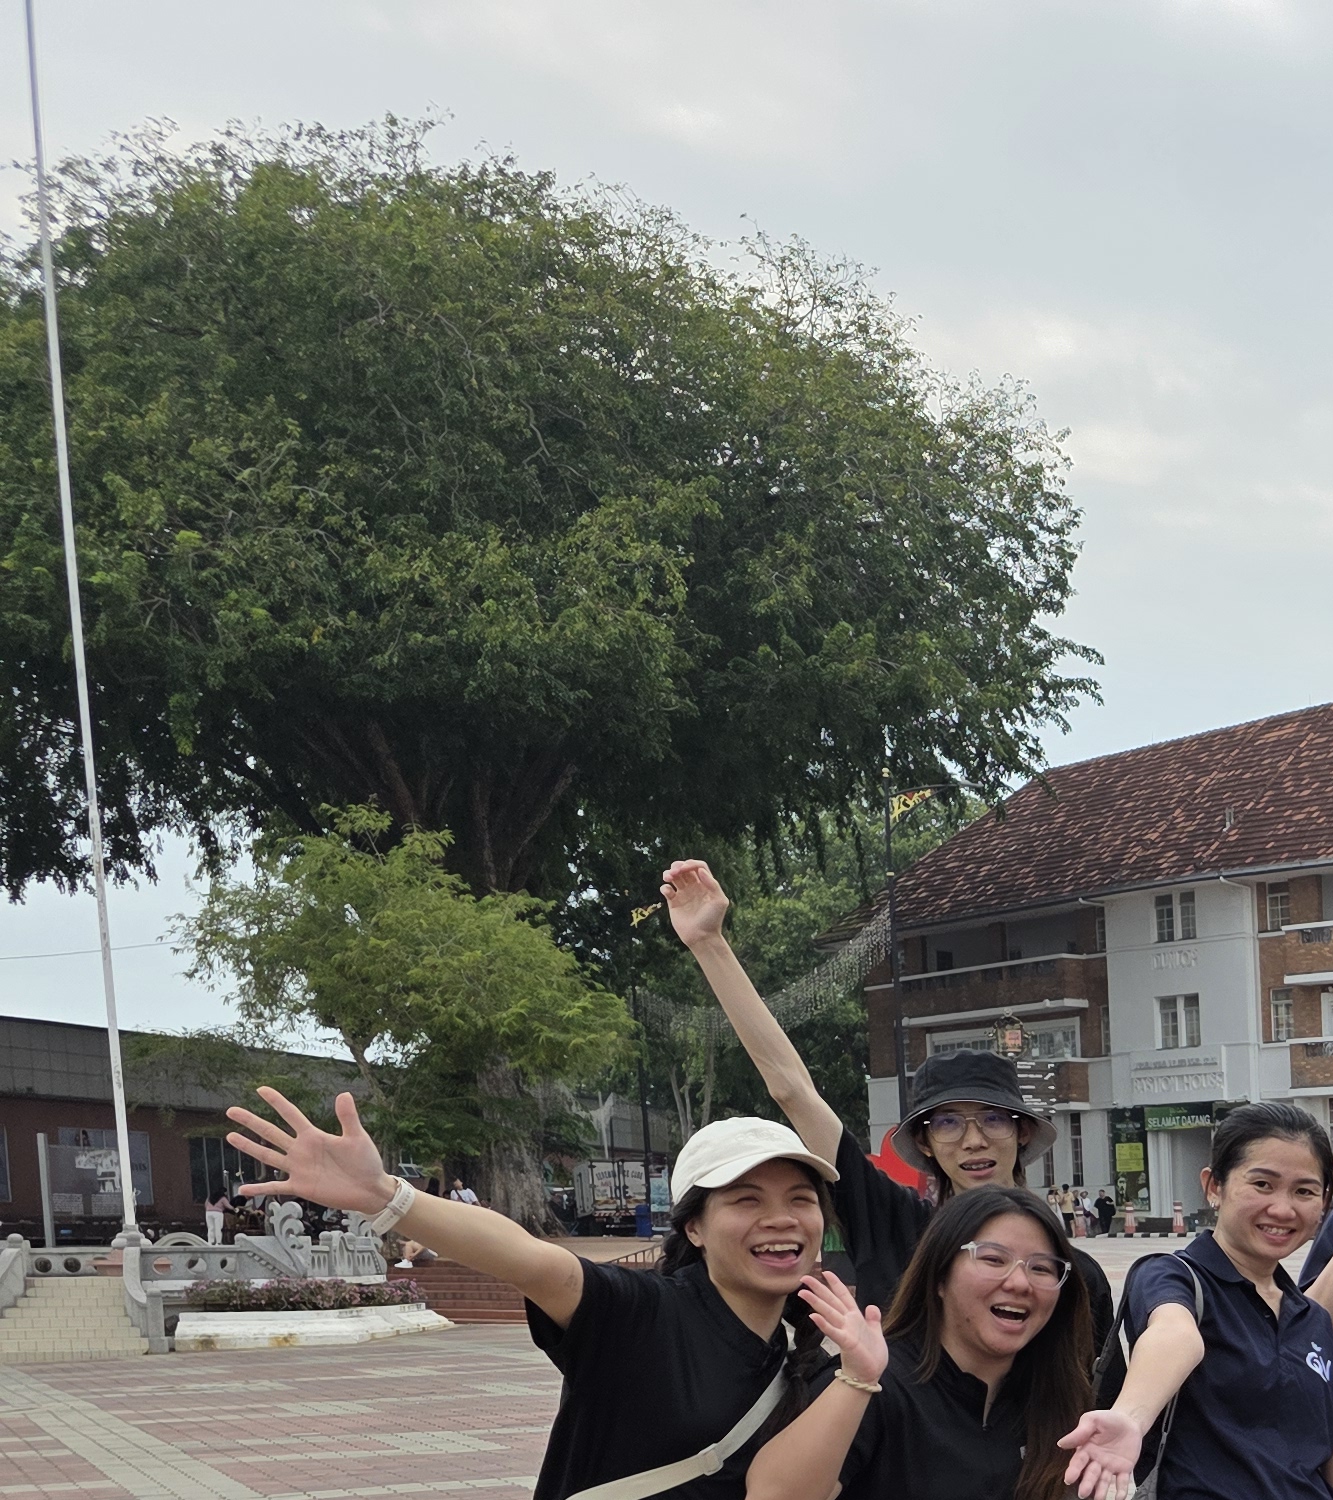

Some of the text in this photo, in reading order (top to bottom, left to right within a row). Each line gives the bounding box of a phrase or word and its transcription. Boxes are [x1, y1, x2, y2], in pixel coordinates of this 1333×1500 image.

[1147, 1115, 1180, 1128] SELAMAT
[1181, 1114, 1211, 1126] DATANG
[1305, 1351, 1332, 1383] QV
